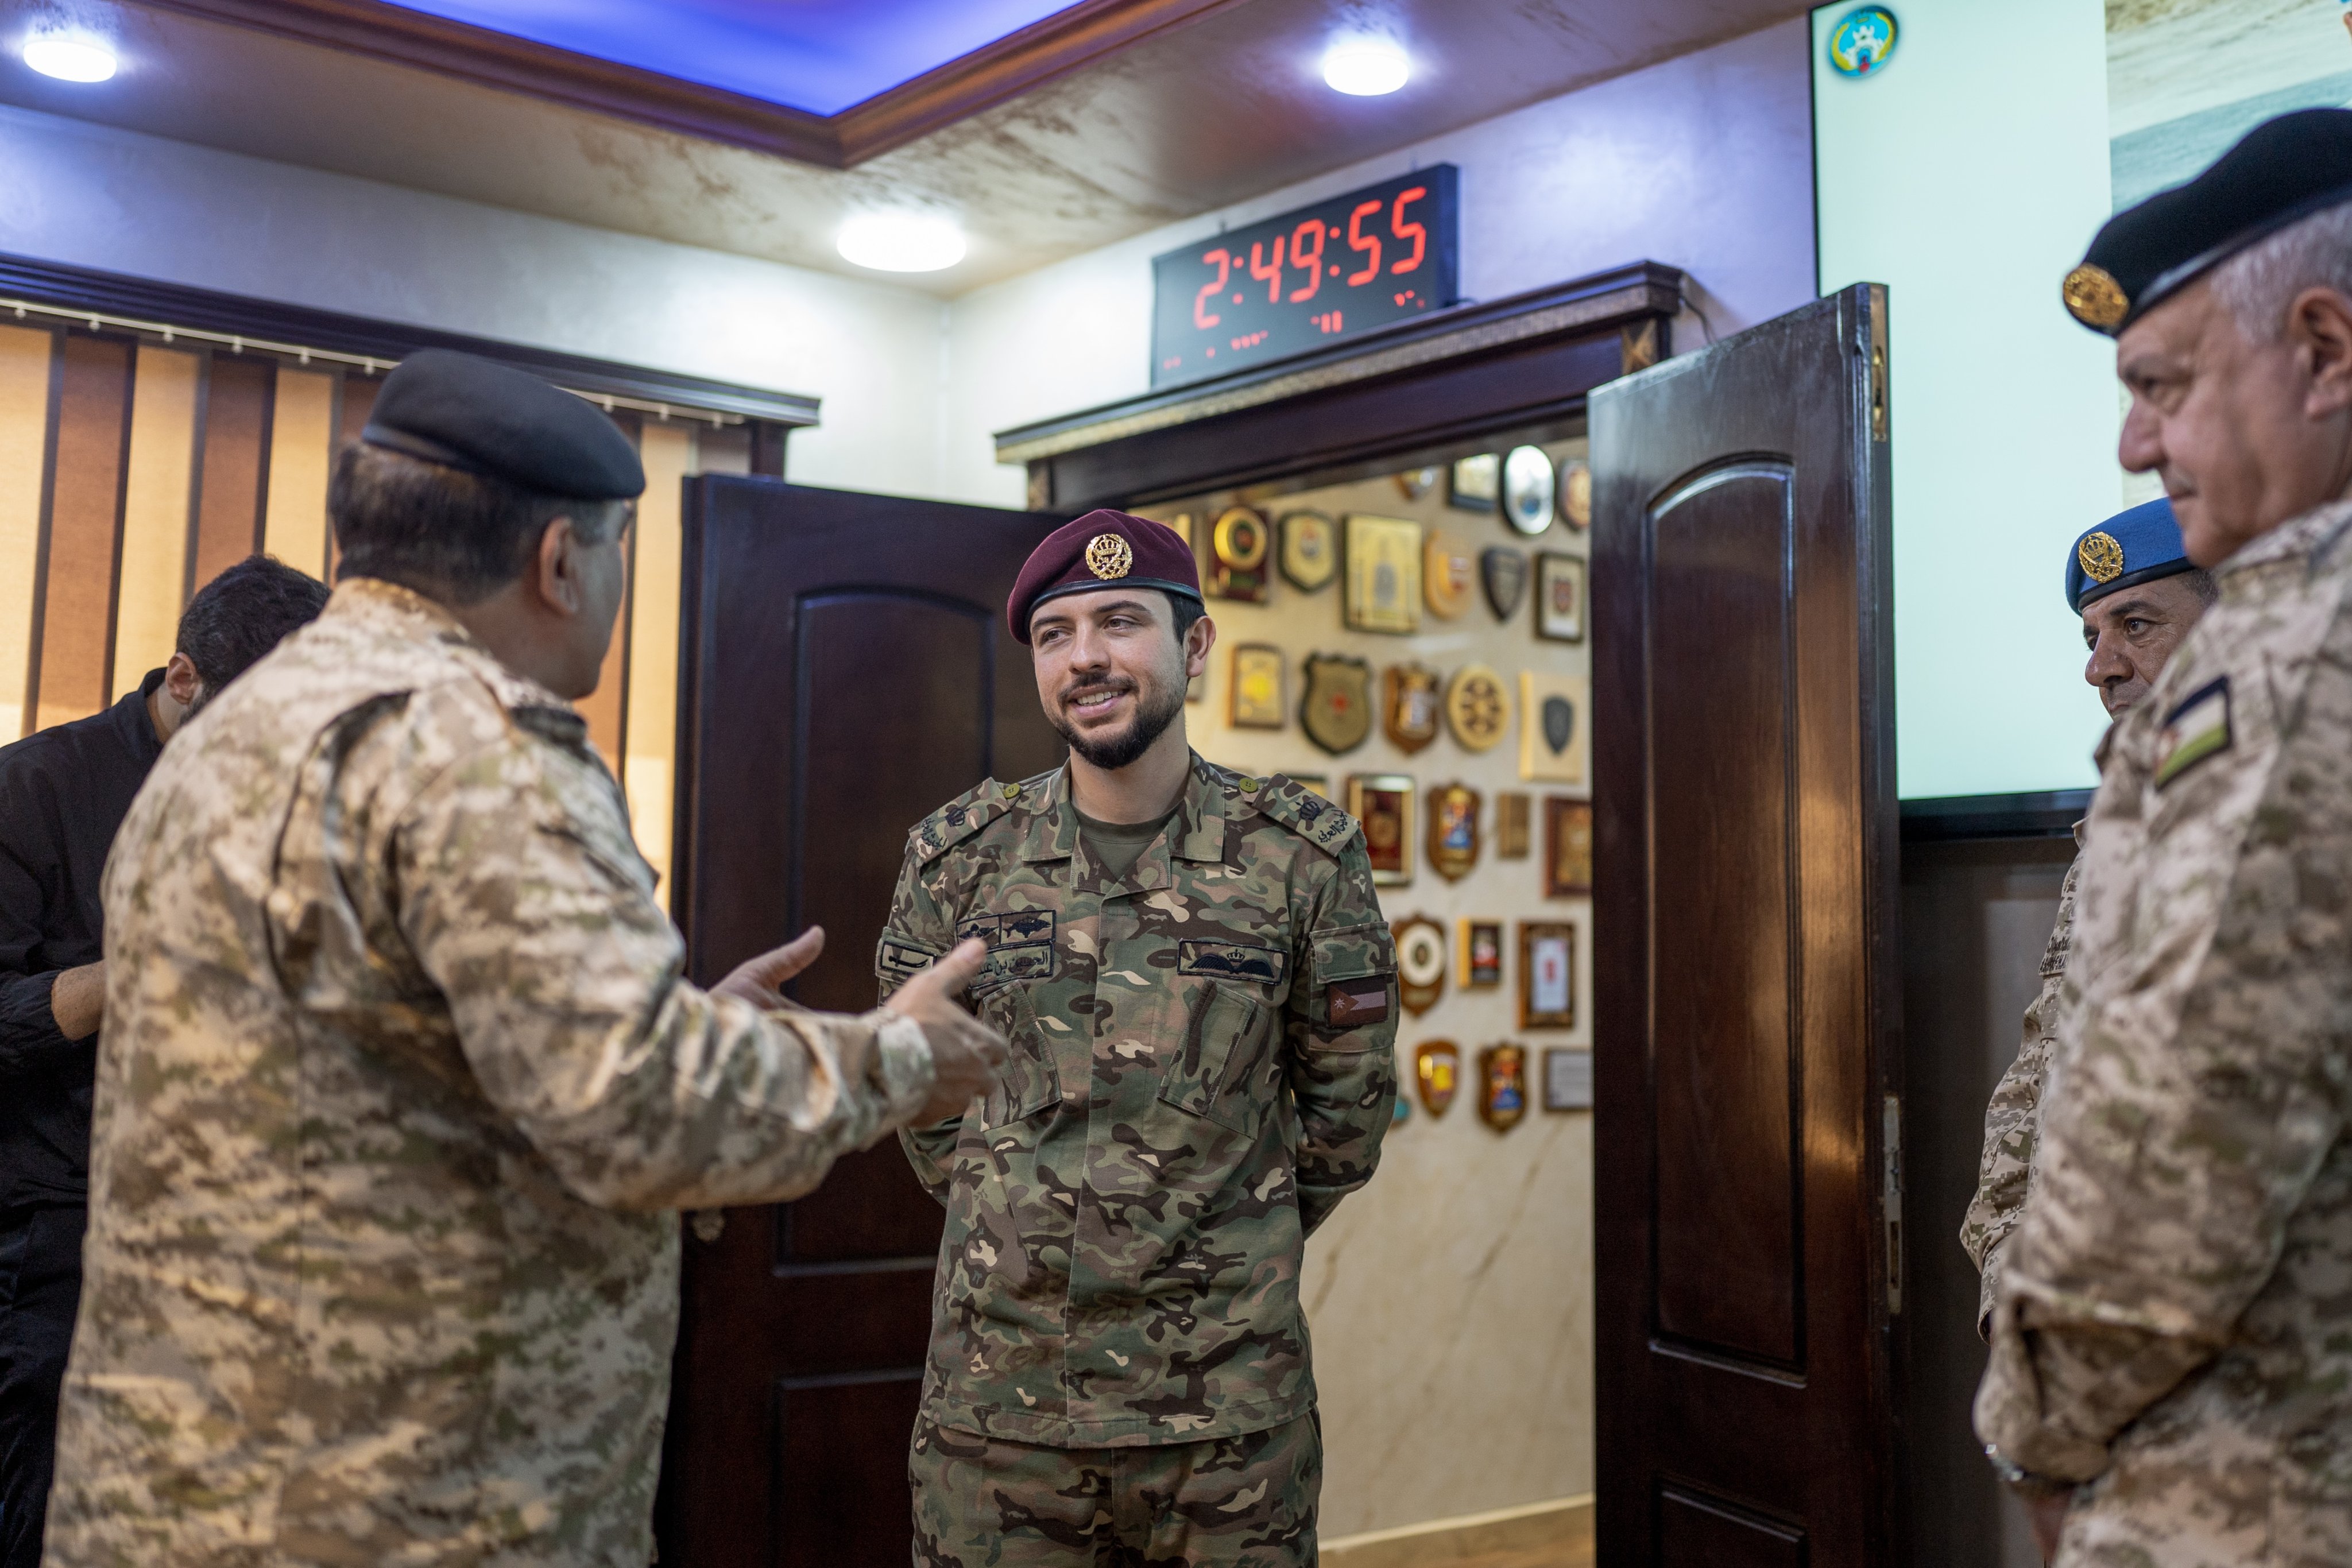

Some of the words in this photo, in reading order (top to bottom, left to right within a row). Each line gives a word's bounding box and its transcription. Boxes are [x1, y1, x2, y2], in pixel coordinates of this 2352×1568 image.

[1194, 186, 1427, 330] 2:49:55
[1331, 809, 1348, 831] الجيش
[922, 833, 948, 851] الجيش
[1318, 824, 1342, 843] العربي
[995, 959, 1008, 976] بن
[1008, 950, 1049, 973] الحسين
